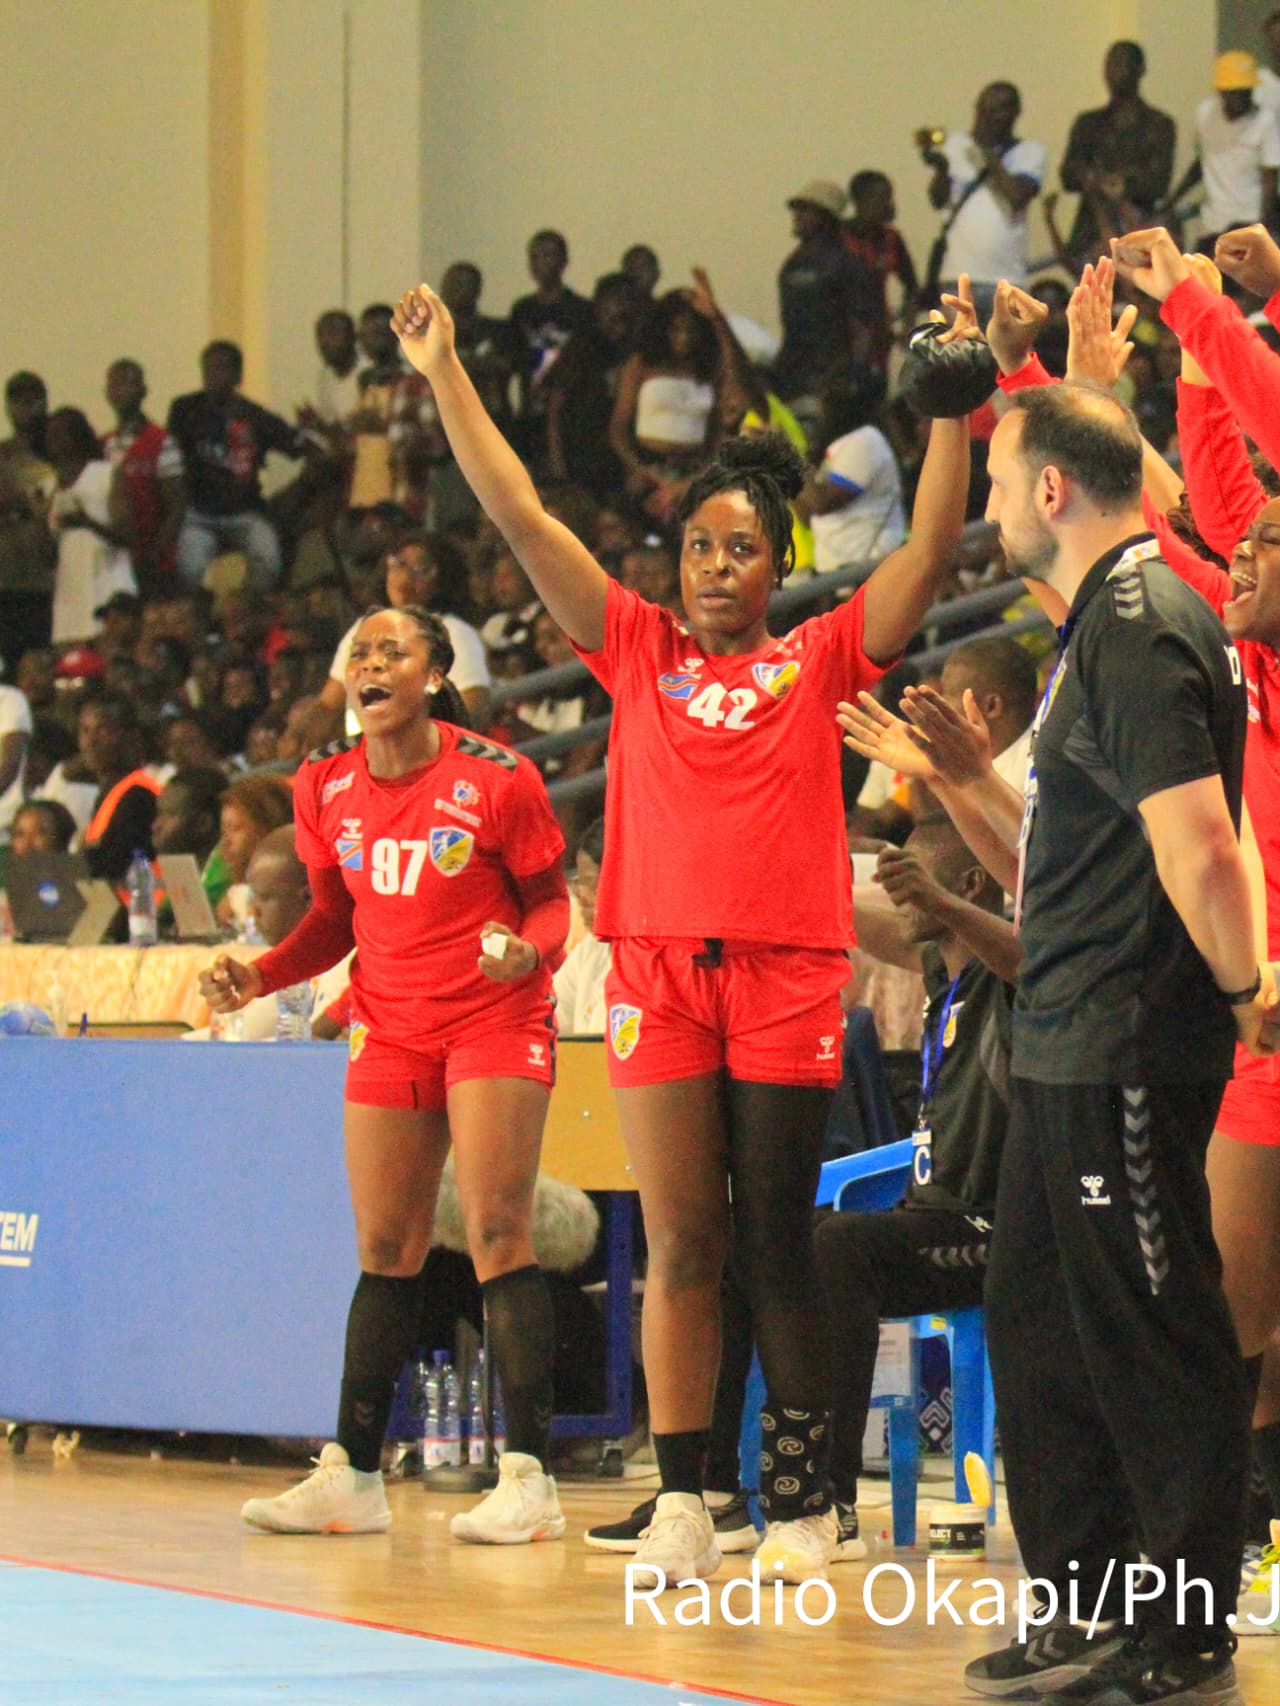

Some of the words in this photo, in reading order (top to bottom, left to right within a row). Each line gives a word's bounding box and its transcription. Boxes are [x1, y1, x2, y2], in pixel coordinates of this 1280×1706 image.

[687, 682, 758, 731] 42
[371, 837, 428, 896] 97
[914, 1145, 931, 1186] C
